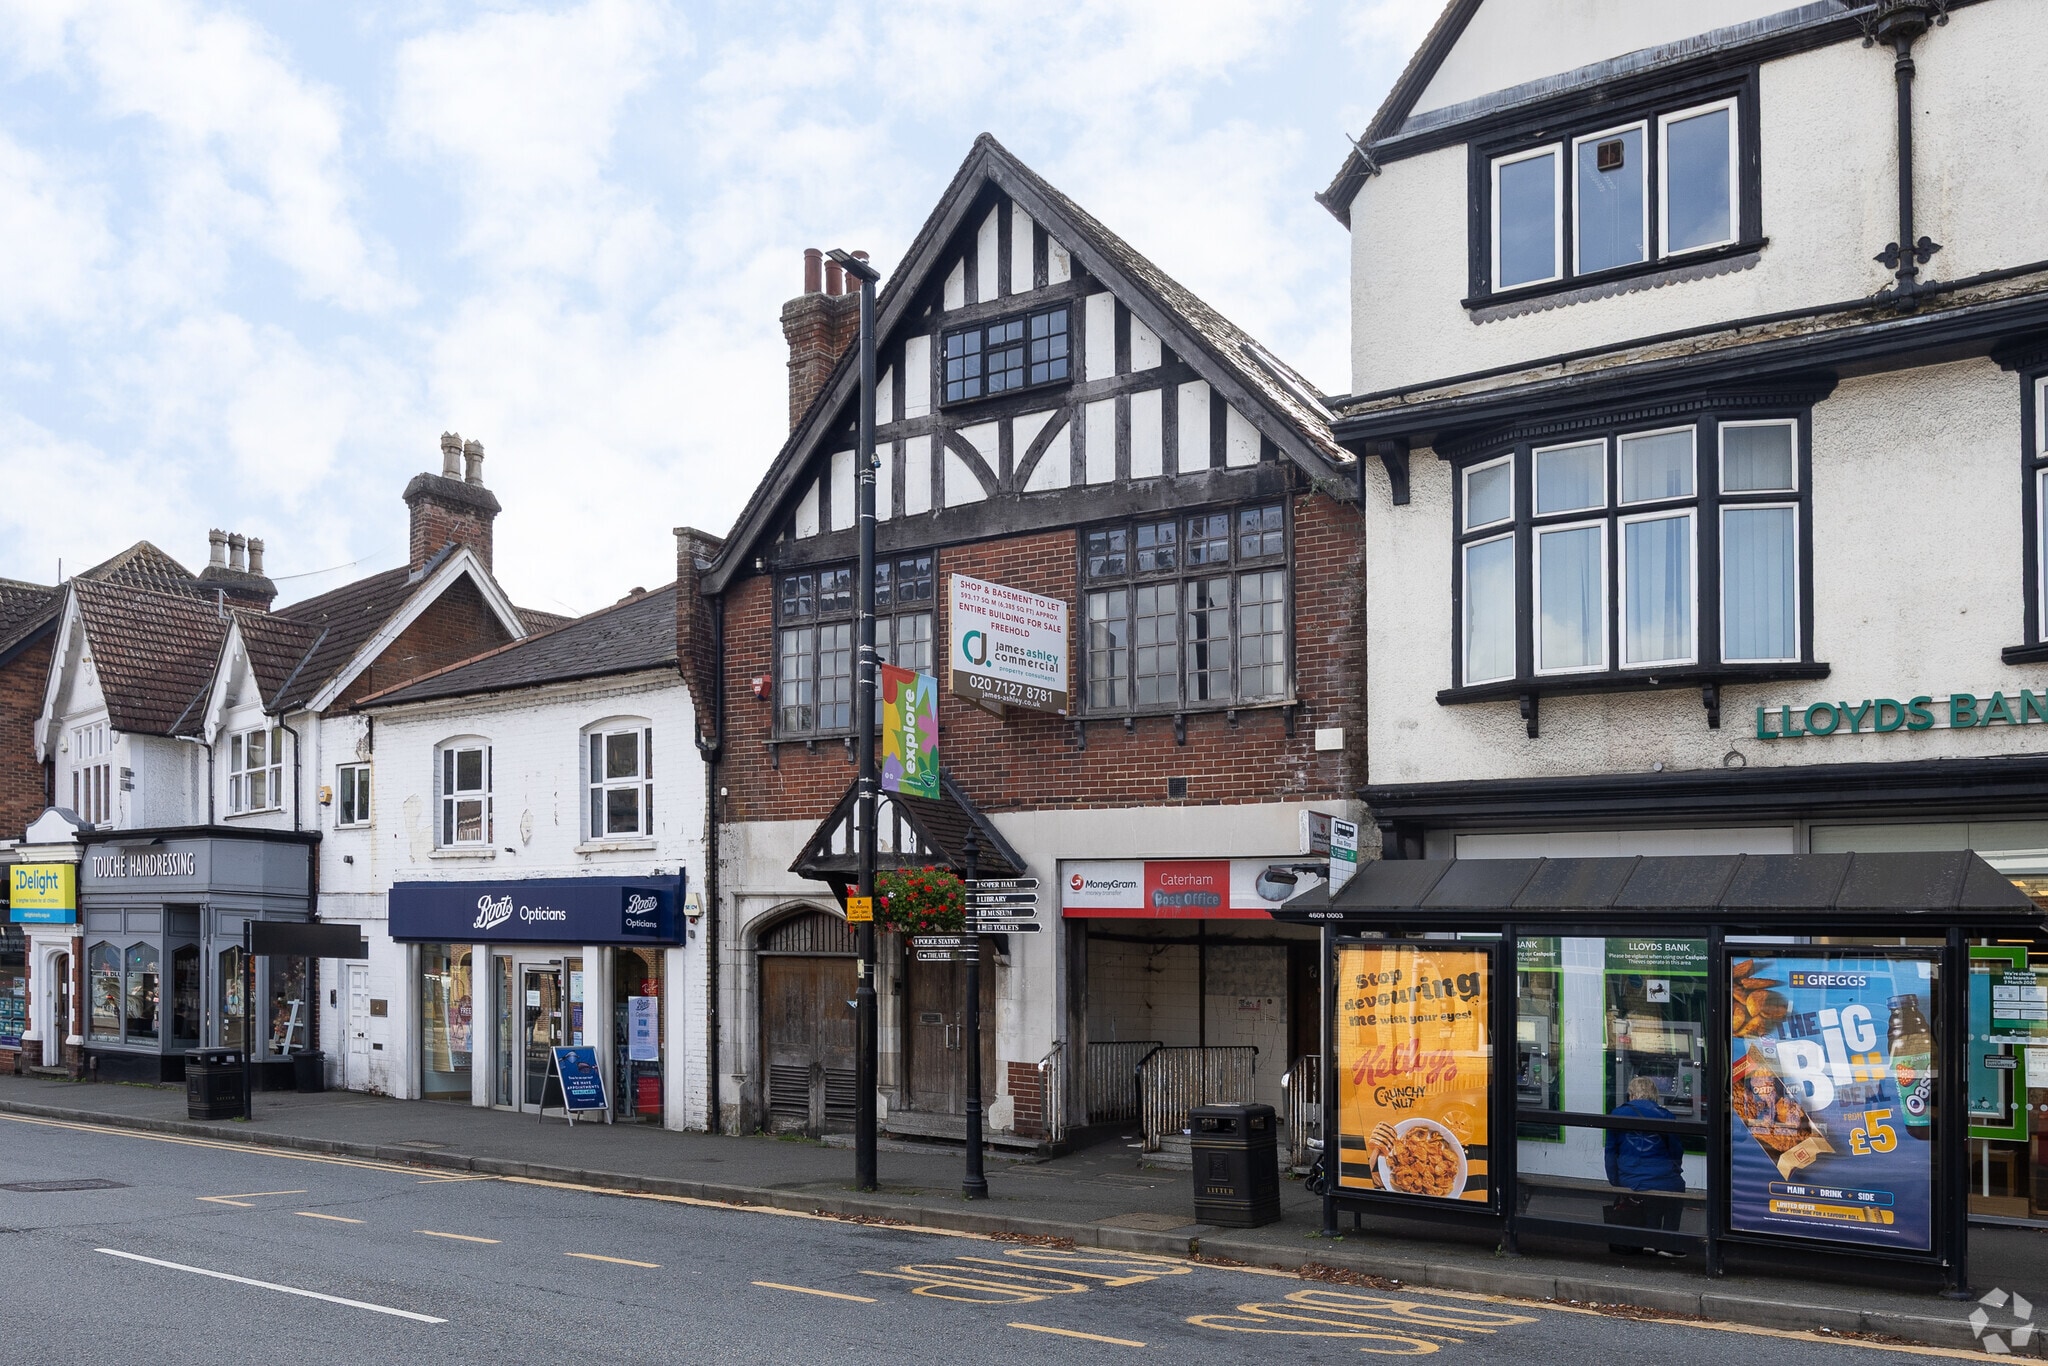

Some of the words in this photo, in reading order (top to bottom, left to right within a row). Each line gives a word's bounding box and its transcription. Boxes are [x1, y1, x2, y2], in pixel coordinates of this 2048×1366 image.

[960, 580, 982, 594] SHOP
[984, 586, 990, 595] &
[992, 588, 1033, 605] BASEMENT
[1035, 599, 1045, 608] TO
[1047, 602, 1060, 612] LET
[959, 602, 987, 616] ENTIRE
[989, 609, 1025, 625] BUILDING
[1027, 619, 1042, 629] FOR
[1044, 622, 1062, 634] SALE
[1017, 606, 1025, 614] SQ
[1026, 608, 1035, 616] FT)
[1036, 611, 1058, 621] APPROX
[991, 622, 1030, 638] FREEHOLD
[995, 641, 1025, 656] james
[1026, 649, 1059, 665] ashley
[995, 652, 1059, 673] commercial
[999, 666, 1024, 677] property
[1025, 671, 1056, 683] consultants
[969, 675, 992, 691] 020
[995, 680, 1023, 697] 7127
[1026, 688, 1053, 703] 8781
[982, 689, 1041, 708] james-ashley.co.uk
[1756, 695, 1935, 740] LLOYDS
[903, 688, 918, 774] explore
[130, 852, 195, 878] HAIRDRESSING
[1001, 880, 1018, 888] HALL
[1160, 873, 1214, 886] Caterham
[625, 893, 658, 916] Boots
[980, 895, 1007, 903] LIBRARY
[1155, 892, 1180, 905] Post
[1184, 892, 1219, 905] Office
[473, 894, 514, 930] Boots
[519, 905, 566, 925] Opticians
[987, 909, 1012, 917] MUSEUM
[625, 918, 658, 929] Opticians
[1629, 943, 1662, 951] LLOYDS
[1665, 943, 1690, 952] BANK
[1807, 974, 1867, 987] GREGGS
[1344, 972, 1481, 1011] devouring
[1349, 1014, 1377, 1027] me
[1380, 1015, 1408, 1025] with
[1409, 1014, 1438, 1025] your
[1441, 1010, 1472, 1022] eyes!
[1776, 1012, 1821, 1040] THE
[1838, 1083, 1891, 1108] DEAL
[1843, 1112, 1863, 1121] FROM
[1207, 1187, 1234, 1195] LITTER
[1787, 1186, 1806, 1195] MAIN
[1820, 1189, 1843, 1199] DRINK
[1858, 1192, 1875, 1202] SIDE
[1776, 1201, 1798, 1210] LIMITED
[1798, 1203, 1816, 1211] OFFER
[1185, 1289, 1541, 1355] BUS
